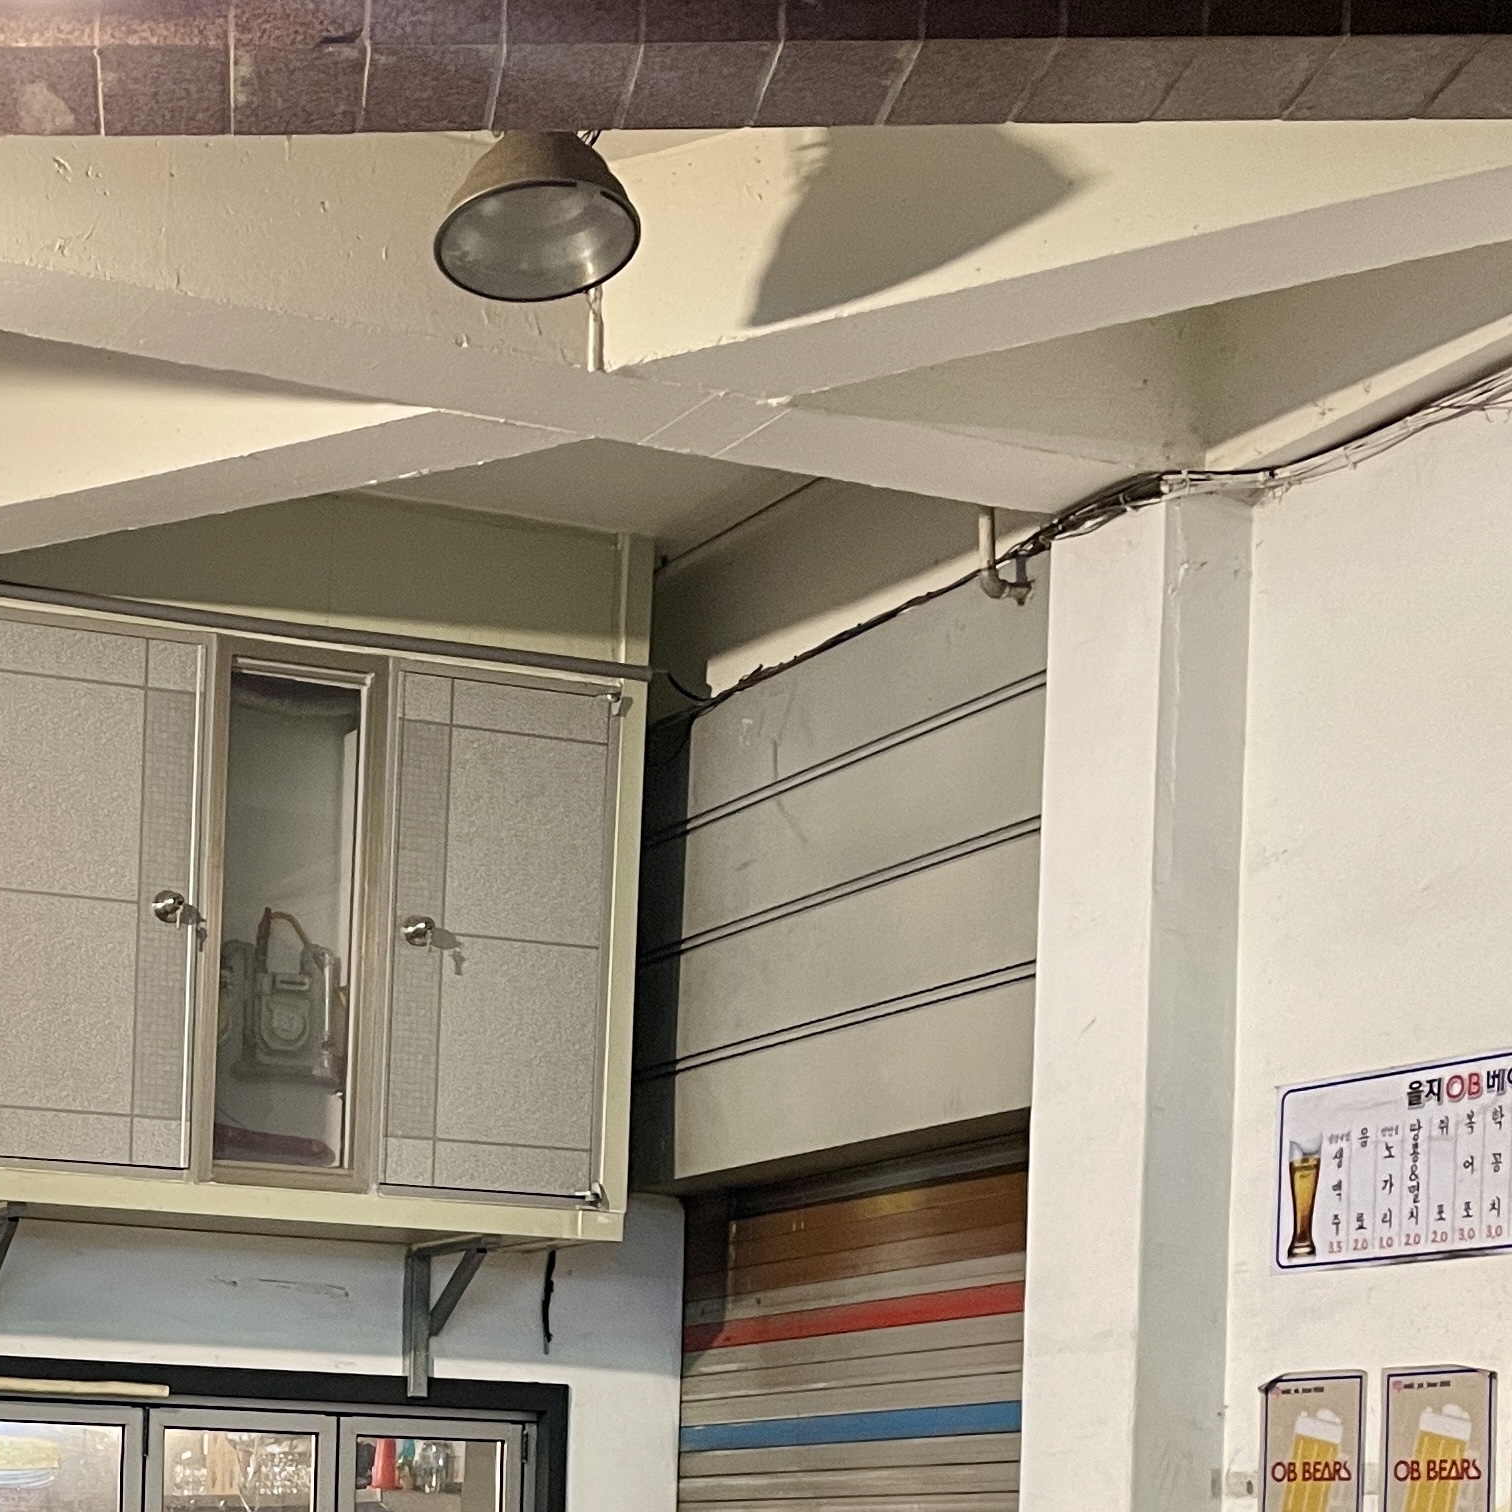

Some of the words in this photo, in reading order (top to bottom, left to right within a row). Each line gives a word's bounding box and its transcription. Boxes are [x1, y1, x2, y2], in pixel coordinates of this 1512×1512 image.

[1271, 1461, 1298, 1483] OB
[1301, 1460, 1352, 1482] BEARS
[1393, 1459, 1421, 1482] OB
[1426, 1458, 1482, 1481] BEARS
